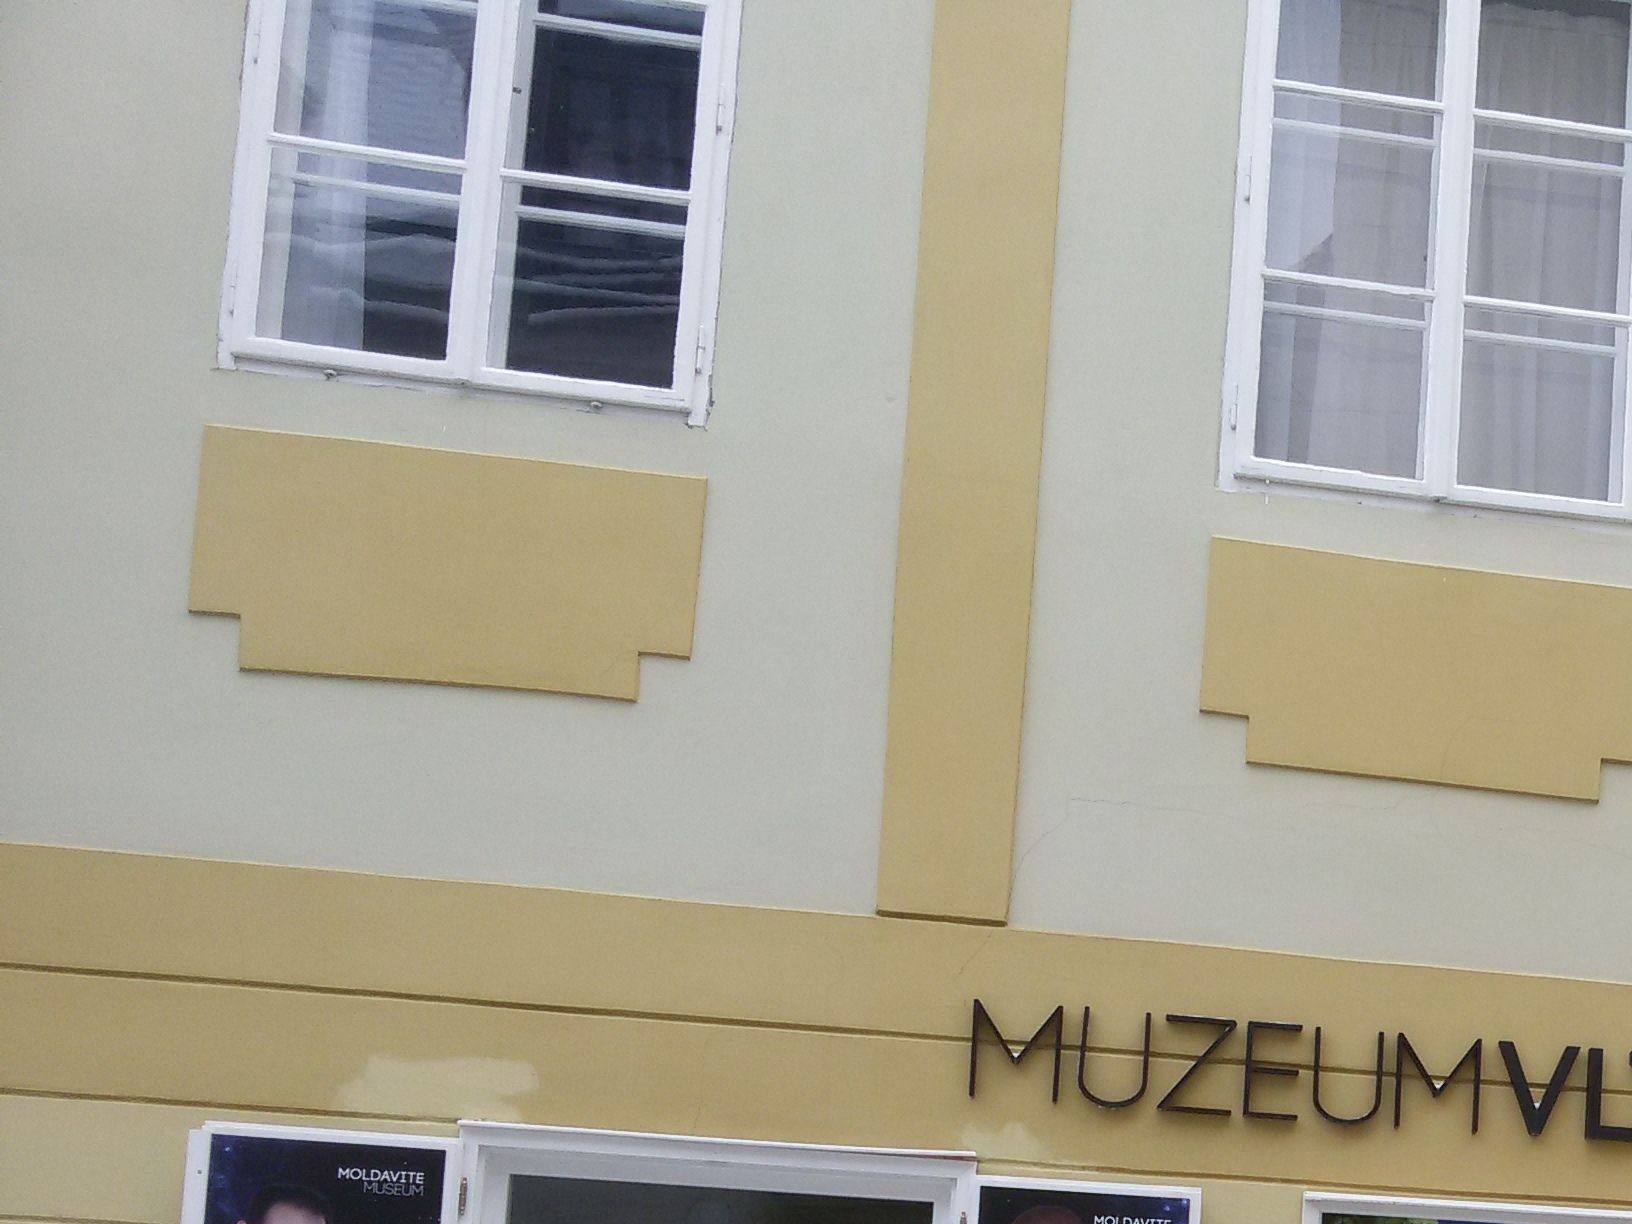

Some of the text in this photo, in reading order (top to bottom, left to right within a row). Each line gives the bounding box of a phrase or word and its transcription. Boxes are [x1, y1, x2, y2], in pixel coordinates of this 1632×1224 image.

[968, 998, 1483, 1135] MUZEUM
[337, 1166, 425, 1185] MOLDAVITE
[363, 1181, 424, 1197] MUSEUM
